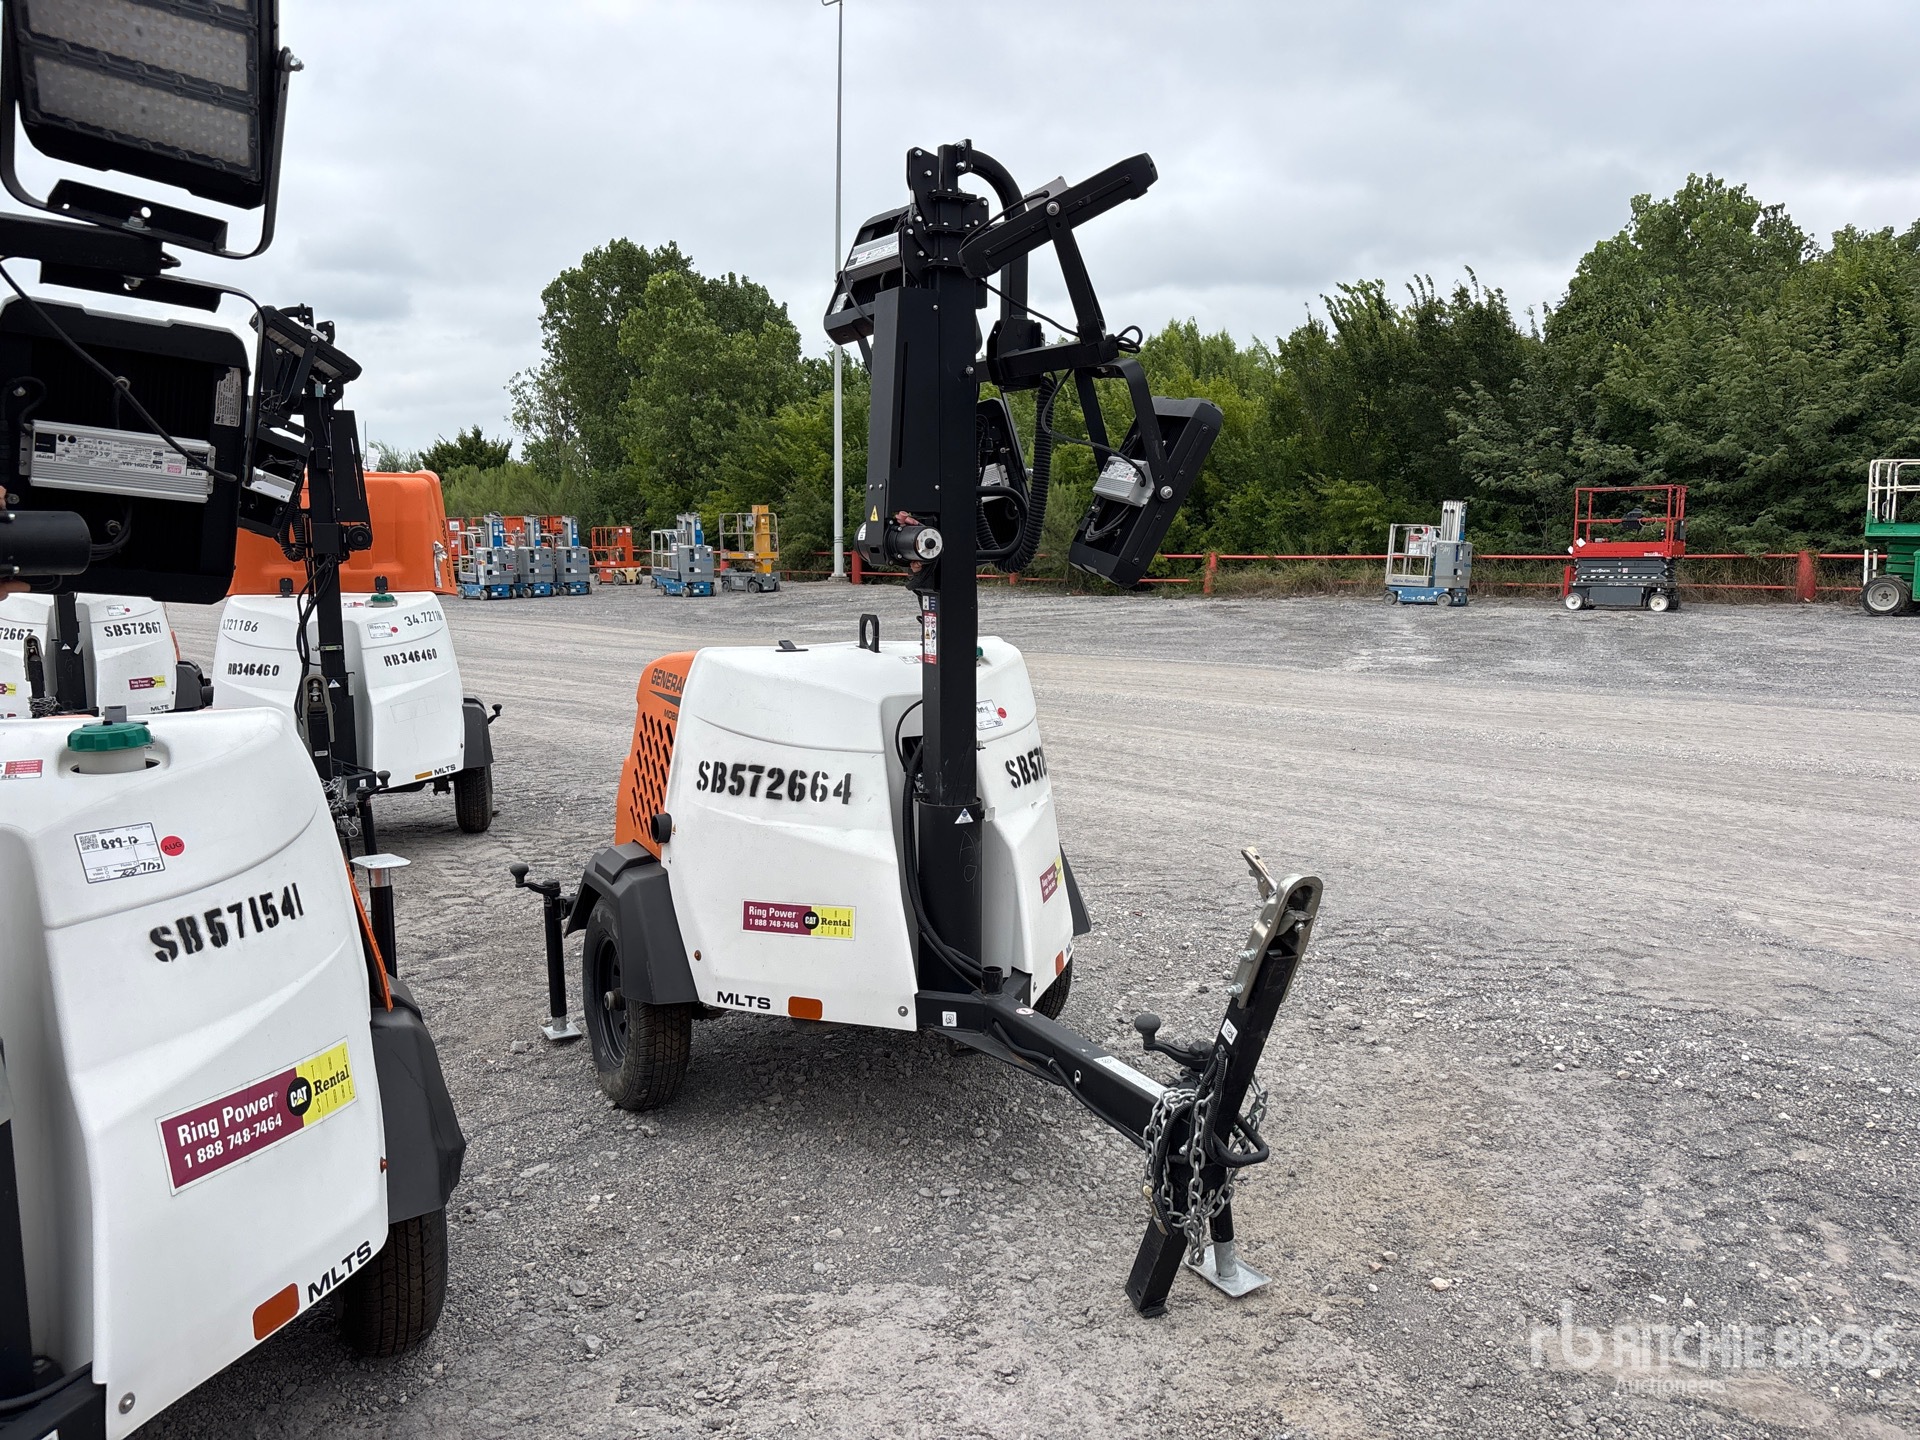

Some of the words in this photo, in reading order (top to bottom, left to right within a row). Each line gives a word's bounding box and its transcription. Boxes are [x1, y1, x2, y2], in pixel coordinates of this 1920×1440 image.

[104, 621, 162, 638] SB572667
[383, 648, 437, 667] RB346460
[228, 663, 279, 677] RB346460
[151, 704, 169, 712] MLTS
[434, 764, 456, 776] MLTS
[696, 760, 852, 804] SB572664
[164, 841, 182, 852] AUG
[150, 882, 304, 962] SB571541
[748, 906, 766, 918] Ring
[769, 906, 797, 919] Power
[805, 916, 817, 924] CAT
[821, 918, 851, 927] Rental
[769, 919, 799, 929] 748-7464
[717, 990, 771, 1010] MLTS
[313, 1064, 350, 1097] Rental
[289, 1085, 308, 1108] CAT
[316, 1080, 352, 1113] STORE
[176, 1116, 219, 1147] Ring
[222, 1092, 275, 1128] Power
[184, 1153, 193, 1168] 1
[197, 1140, 224, 1163] 888
[227, 1112, 283, 1150] 748-7464
[308, 1240, 372, 1304] MLTS
